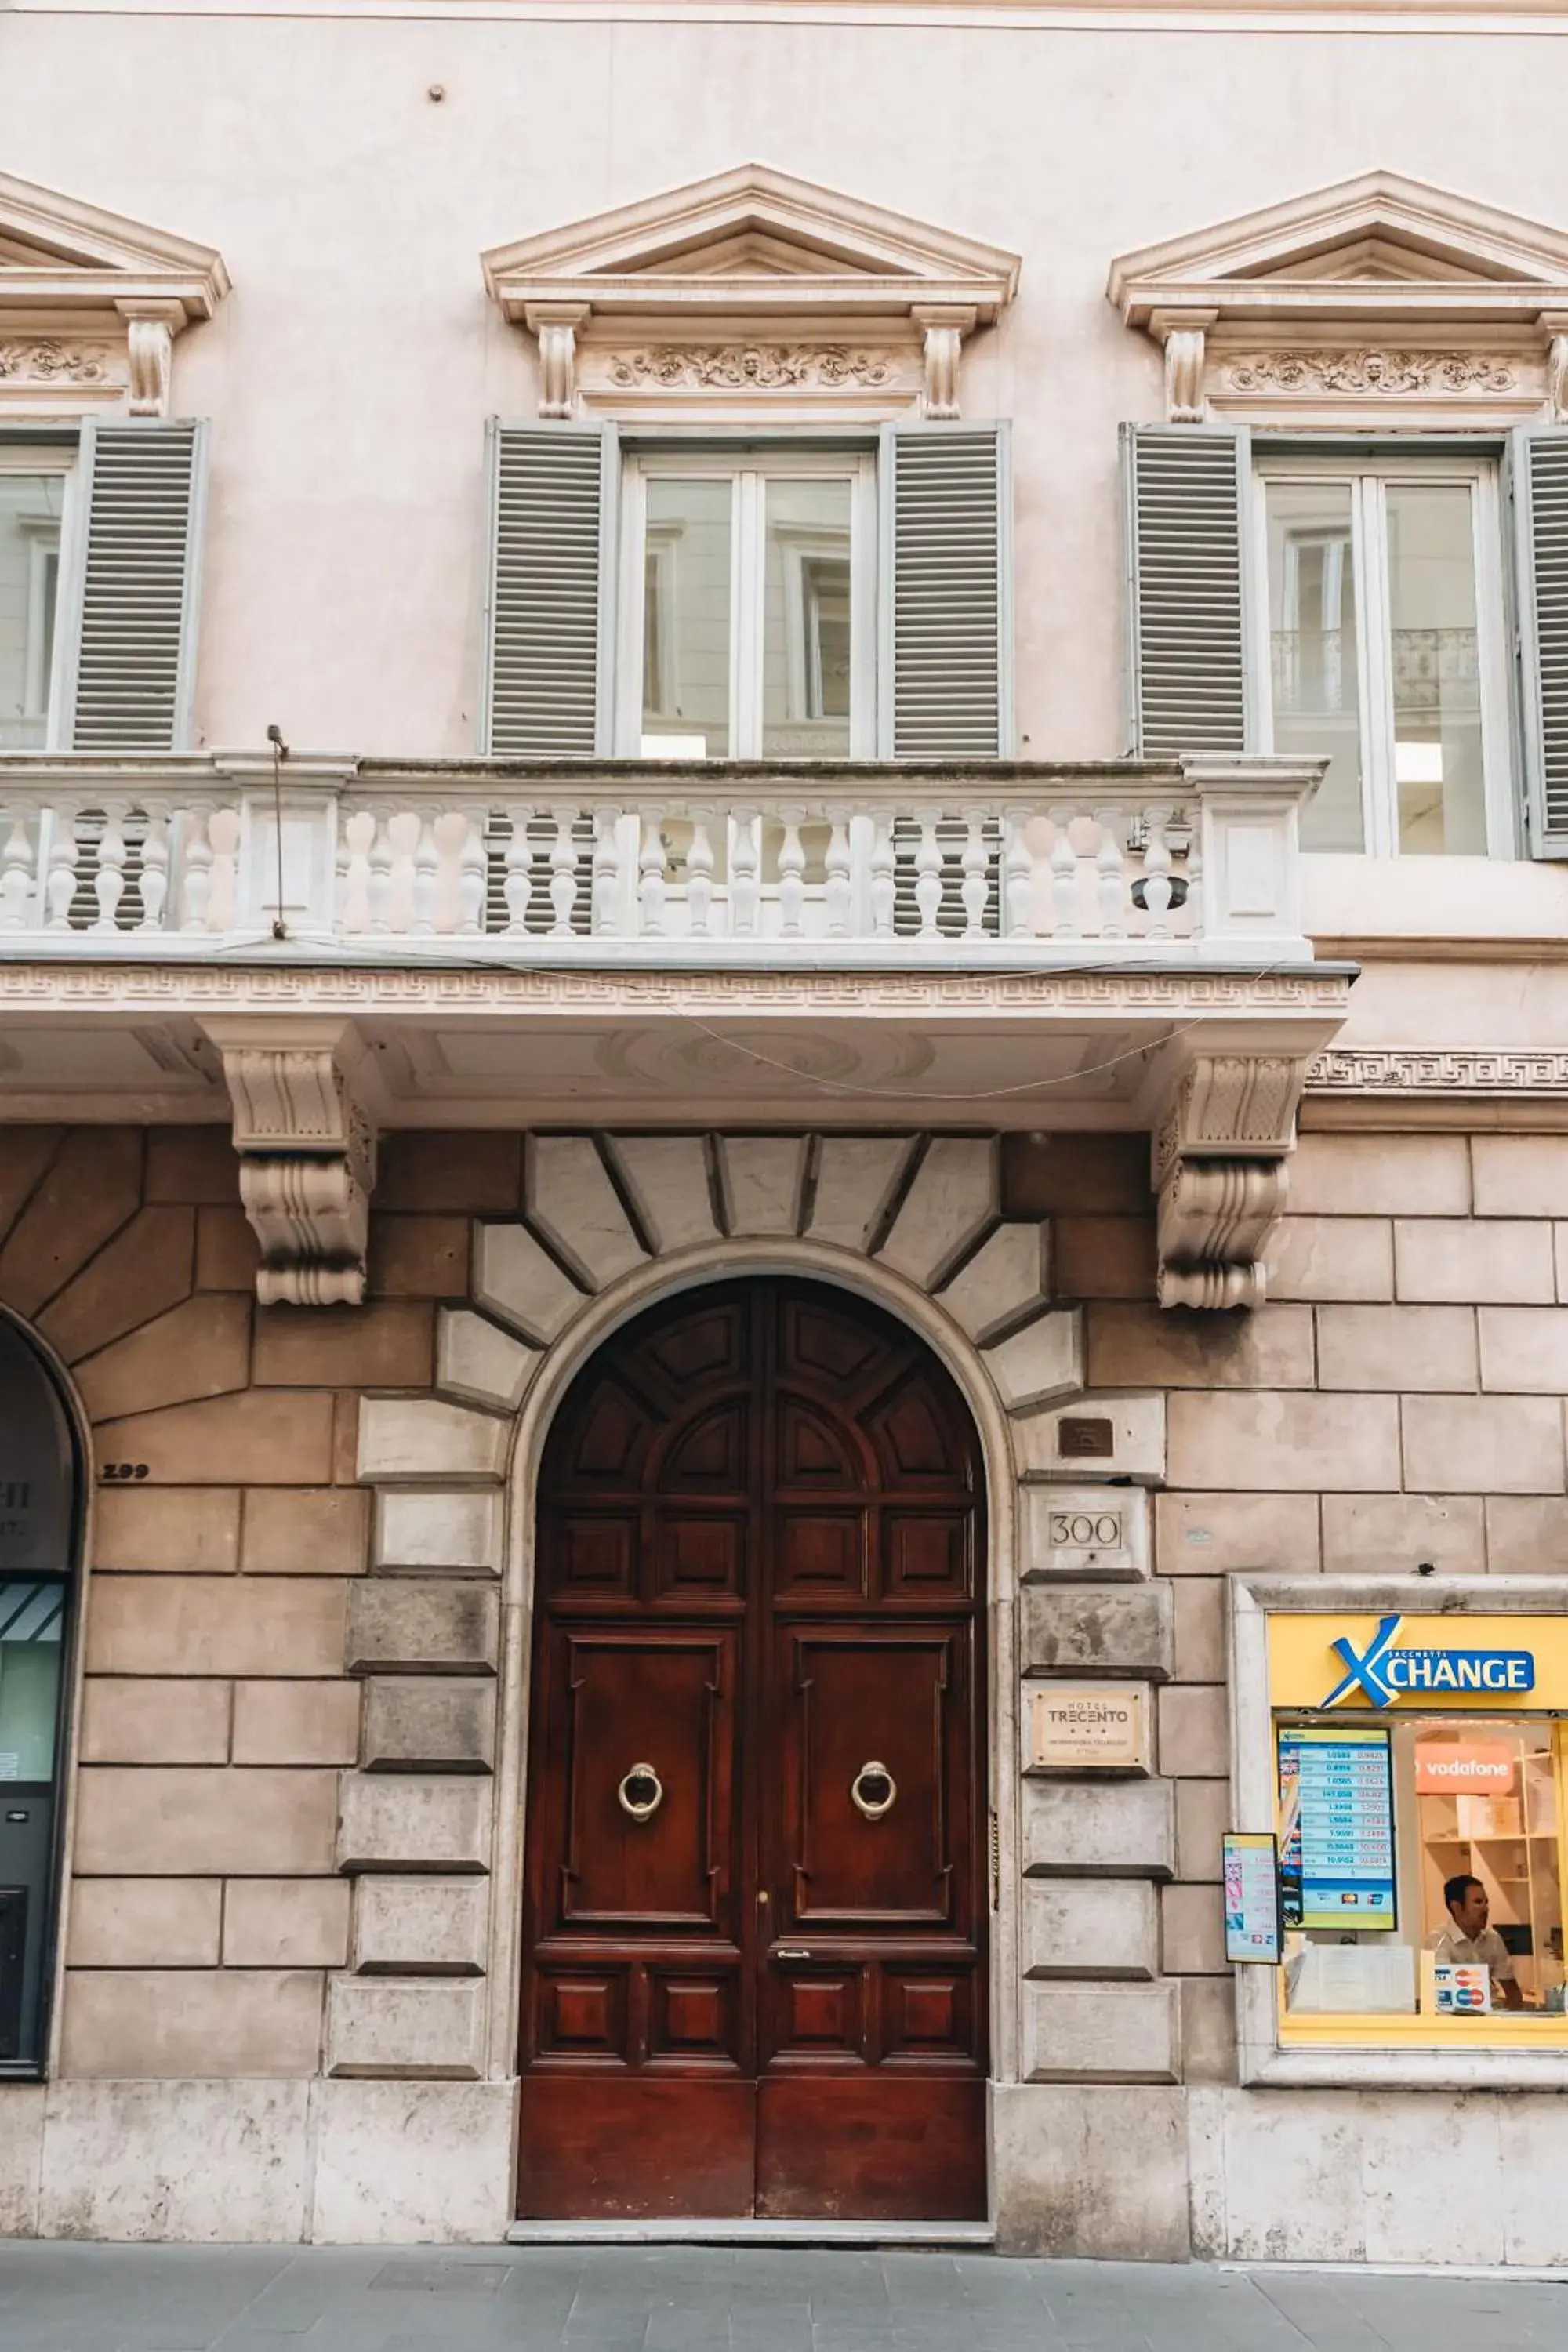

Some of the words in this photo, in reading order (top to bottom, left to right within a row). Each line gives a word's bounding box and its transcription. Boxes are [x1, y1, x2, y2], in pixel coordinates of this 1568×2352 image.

[1053, 1515, 1119, 1544] 300
[1047, 1710, 1129, 1723] TRECENTO
[1427, 1759, 1508, 1776] vodafone
